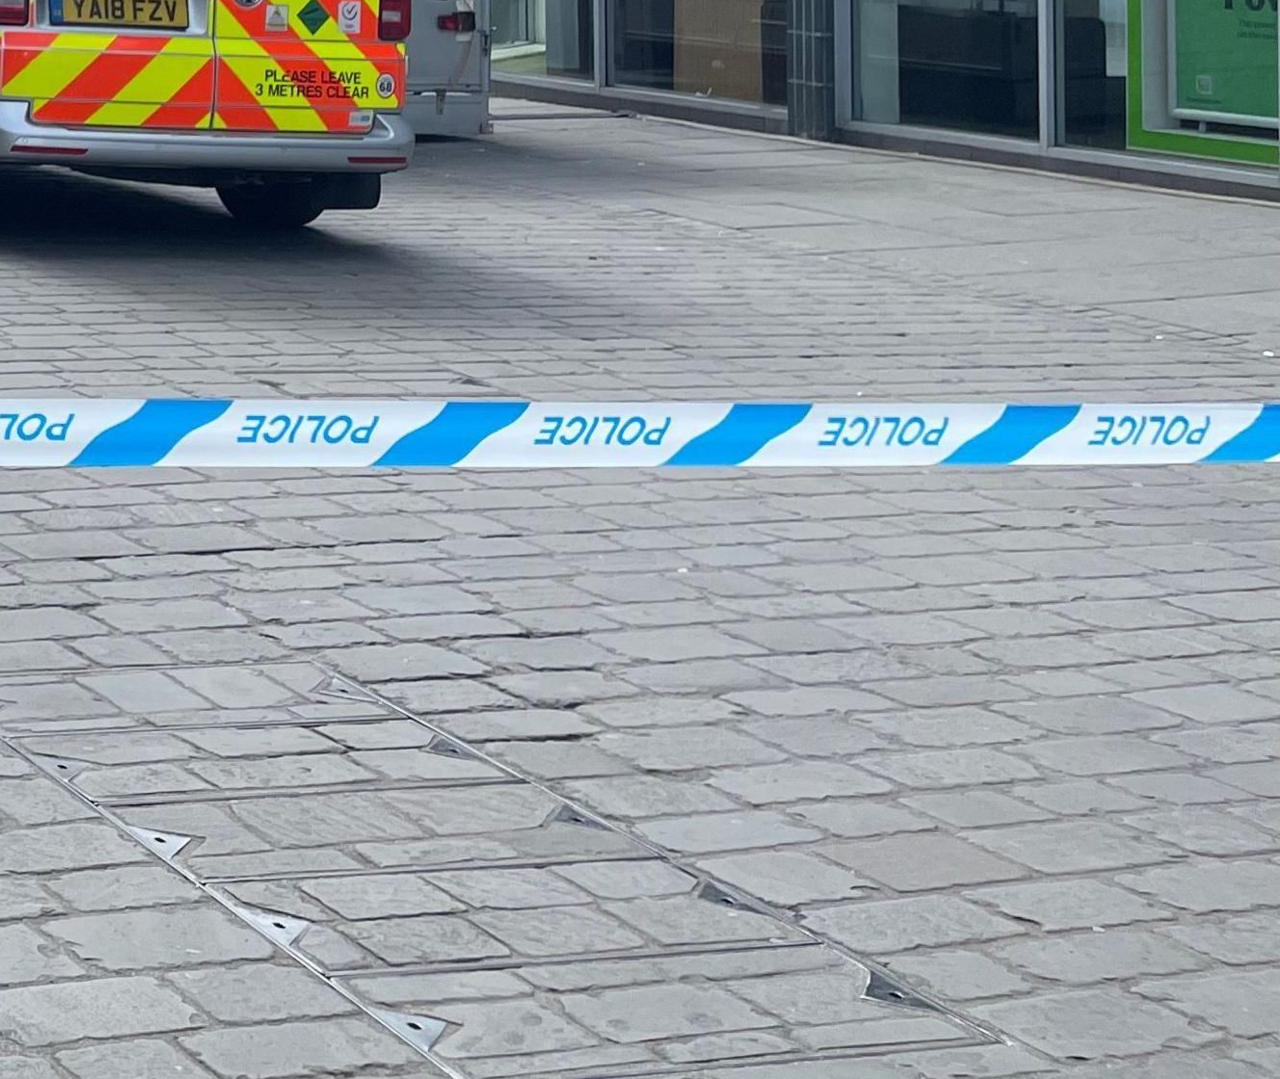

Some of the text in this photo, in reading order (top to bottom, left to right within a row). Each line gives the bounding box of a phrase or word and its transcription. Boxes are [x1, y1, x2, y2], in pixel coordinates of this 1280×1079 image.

[265, 69, 362, 85] PLEASE LEAVE
[255, 84, 369, 99] 3 METRES CLEAR
[236, 414, 381, 445] POLICE
[533, 415, 672, 446] POLICE
[818, 416, 950, 447] POLICE
[1087, 415, 1212, 447] POLICE
